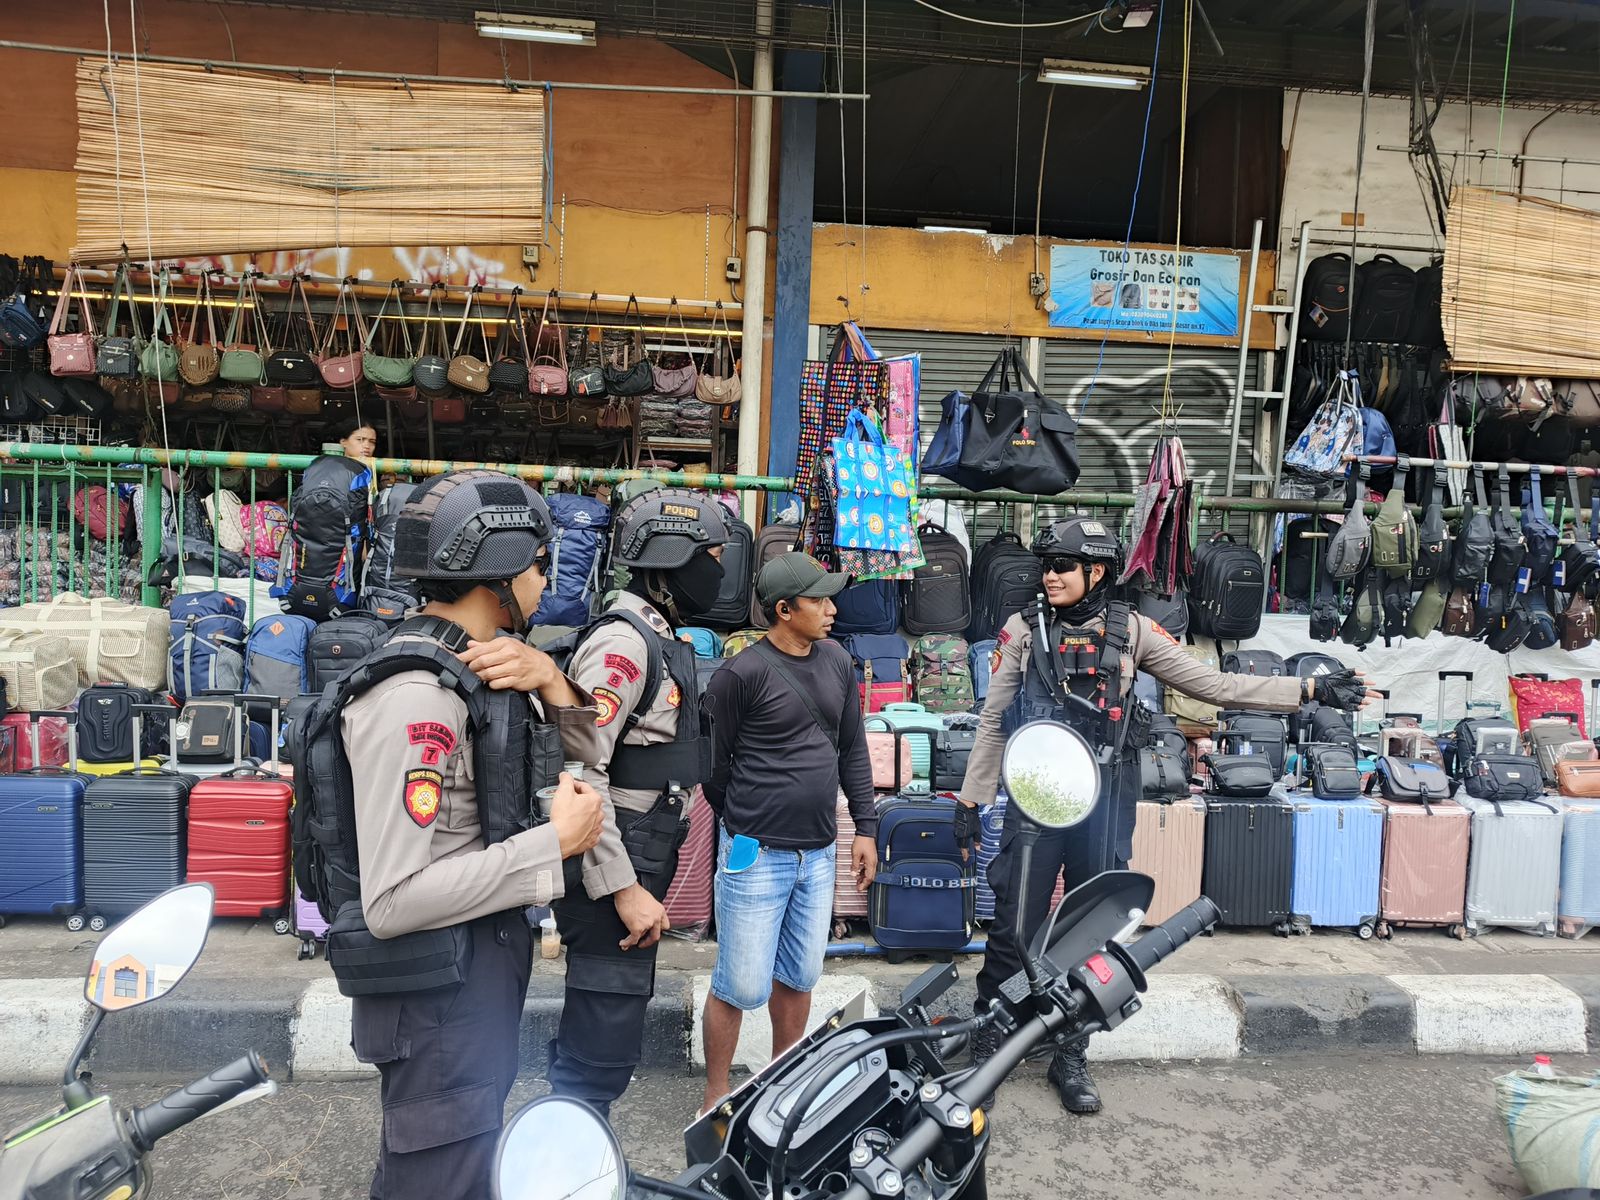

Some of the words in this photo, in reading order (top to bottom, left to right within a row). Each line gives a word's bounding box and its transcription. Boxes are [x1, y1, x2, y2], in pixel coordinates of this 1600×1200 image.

[1099, 250, 1130, 264] TOKO
[1134, 252, 1157, 265] TAS
[1090, 268, 1129, 282] Grosir
[1133, 270, 1155, 283] Dan
[664, 505, 698, 518] POLISI
[1084, 523, 1105, 535] POLISI
[1064, 636, 1090, 645] POLISI
[427, 749, 437, 762] 7
[904, 876, 943, 888] POLO
